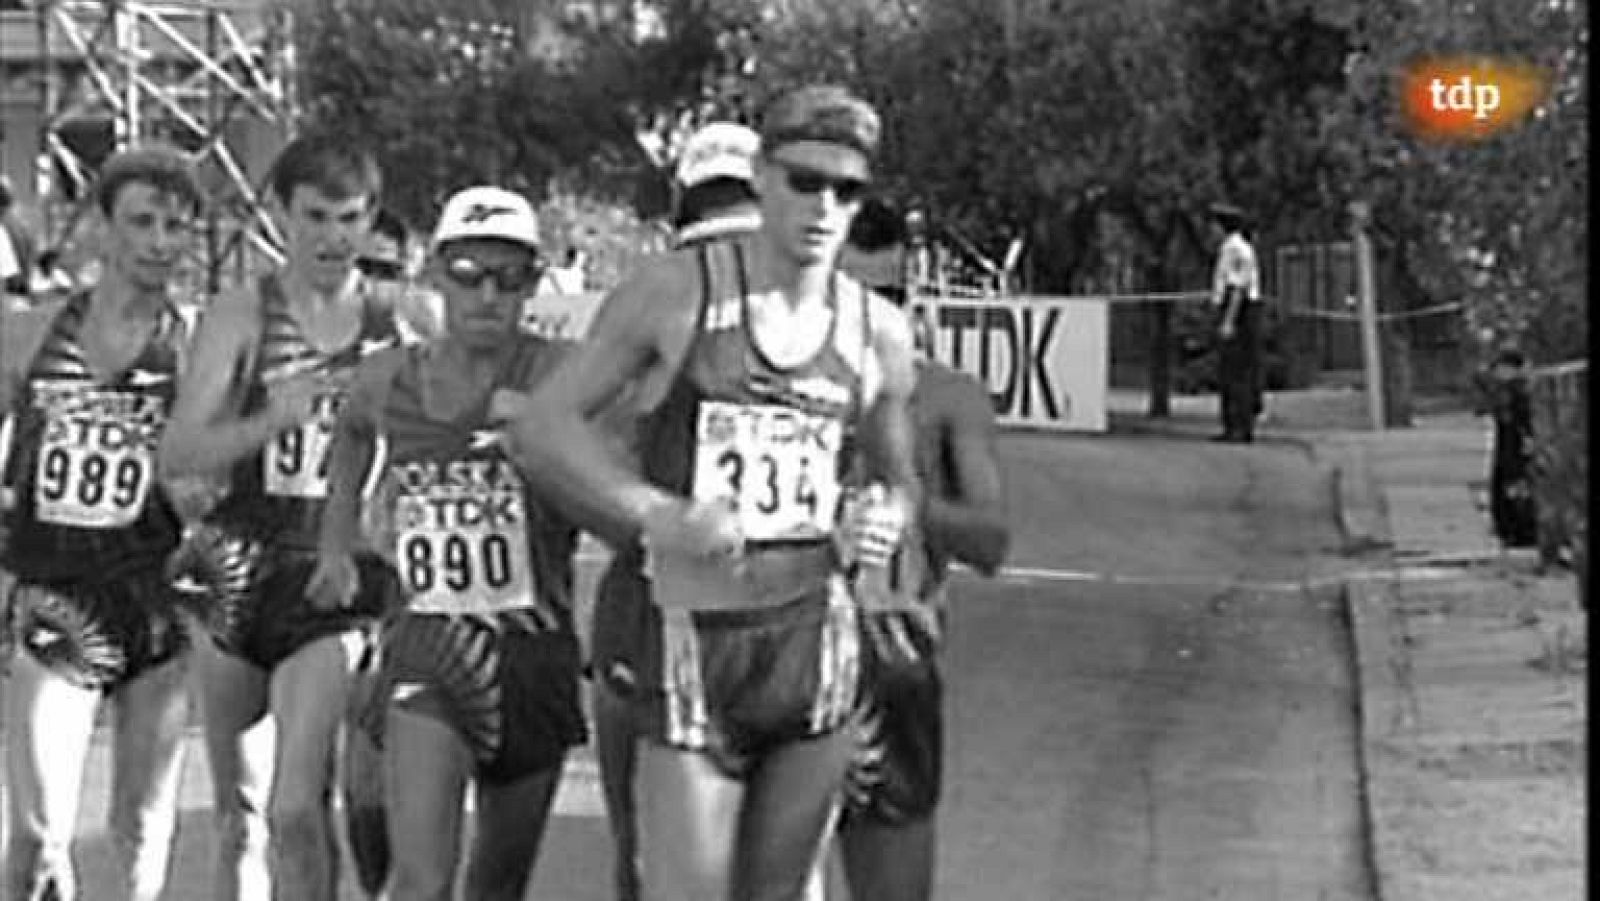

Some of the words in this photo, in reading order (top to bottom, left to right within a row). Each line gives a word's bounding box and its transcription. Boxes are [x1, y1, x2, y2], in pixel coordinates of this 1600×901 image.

[936, 303, 1063, 421] TDK
[42, 447, 145, 507] 989
[717, 450, 820, 518] 334
[428, 494, 518, 530] TDK
[405, 534, 512, 592] 890
